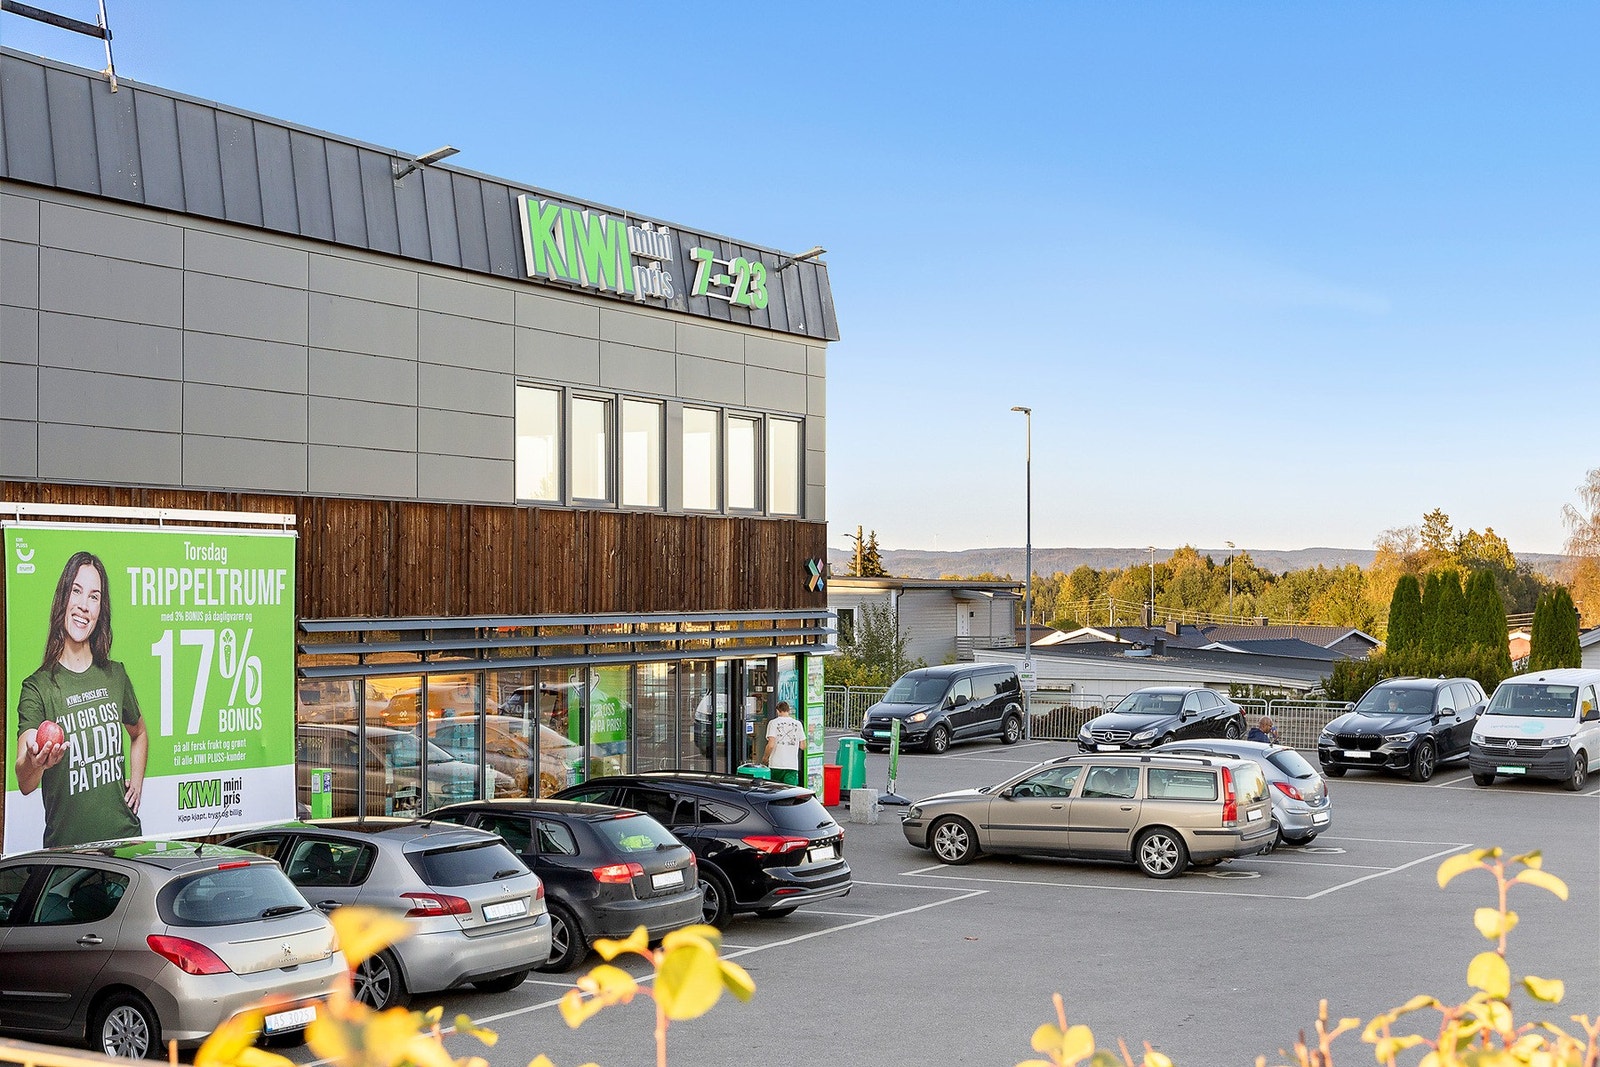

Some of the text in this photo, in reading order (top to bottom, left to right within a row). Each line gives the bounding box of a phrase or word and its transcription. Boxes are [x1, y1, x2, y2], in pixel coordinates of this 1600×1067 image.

[519, 195, 635, 296] KIWI
[628, 221, 673, 262] mini
[633, 261, 675, 301] pris
[690, 247, 768, 309] 7-23
[184, 541, 228, 565] Torsdag
[126, 566, 287, 606] TRIPPELTRUMF
[174, 611, 184, 621] 3%
[184, 611, 204, 622] BONUS
[204, 611, 212, 623] på
[212, 611, 244, 622] dagligvarer
[245, 613, 253, 622] og
[151, 628, 262, 737] 17%
[78, 707, 98, 729] GIR
[98, 702, 119, 722] OSS
[219, 707, 262, 732] BONUS
[69, 722, 122, 769] ALDRI
[174, 738, 246, 754] på all fersk frukt og grønt
[182, 755, 192, 765] alle
[194, 754, 206, 764] KIWI
[208, 751, 246, 763] PLUSS-kunder
[70, 760, 90, 796] PÅ
[224, 777, 242, 792] mini
[178, 779, 222, 810] KIWI
[224, 791, 240, 808] pris
[274, 1014, 285, 1028] AS
[288, 1010, 310, 1025] 3025
